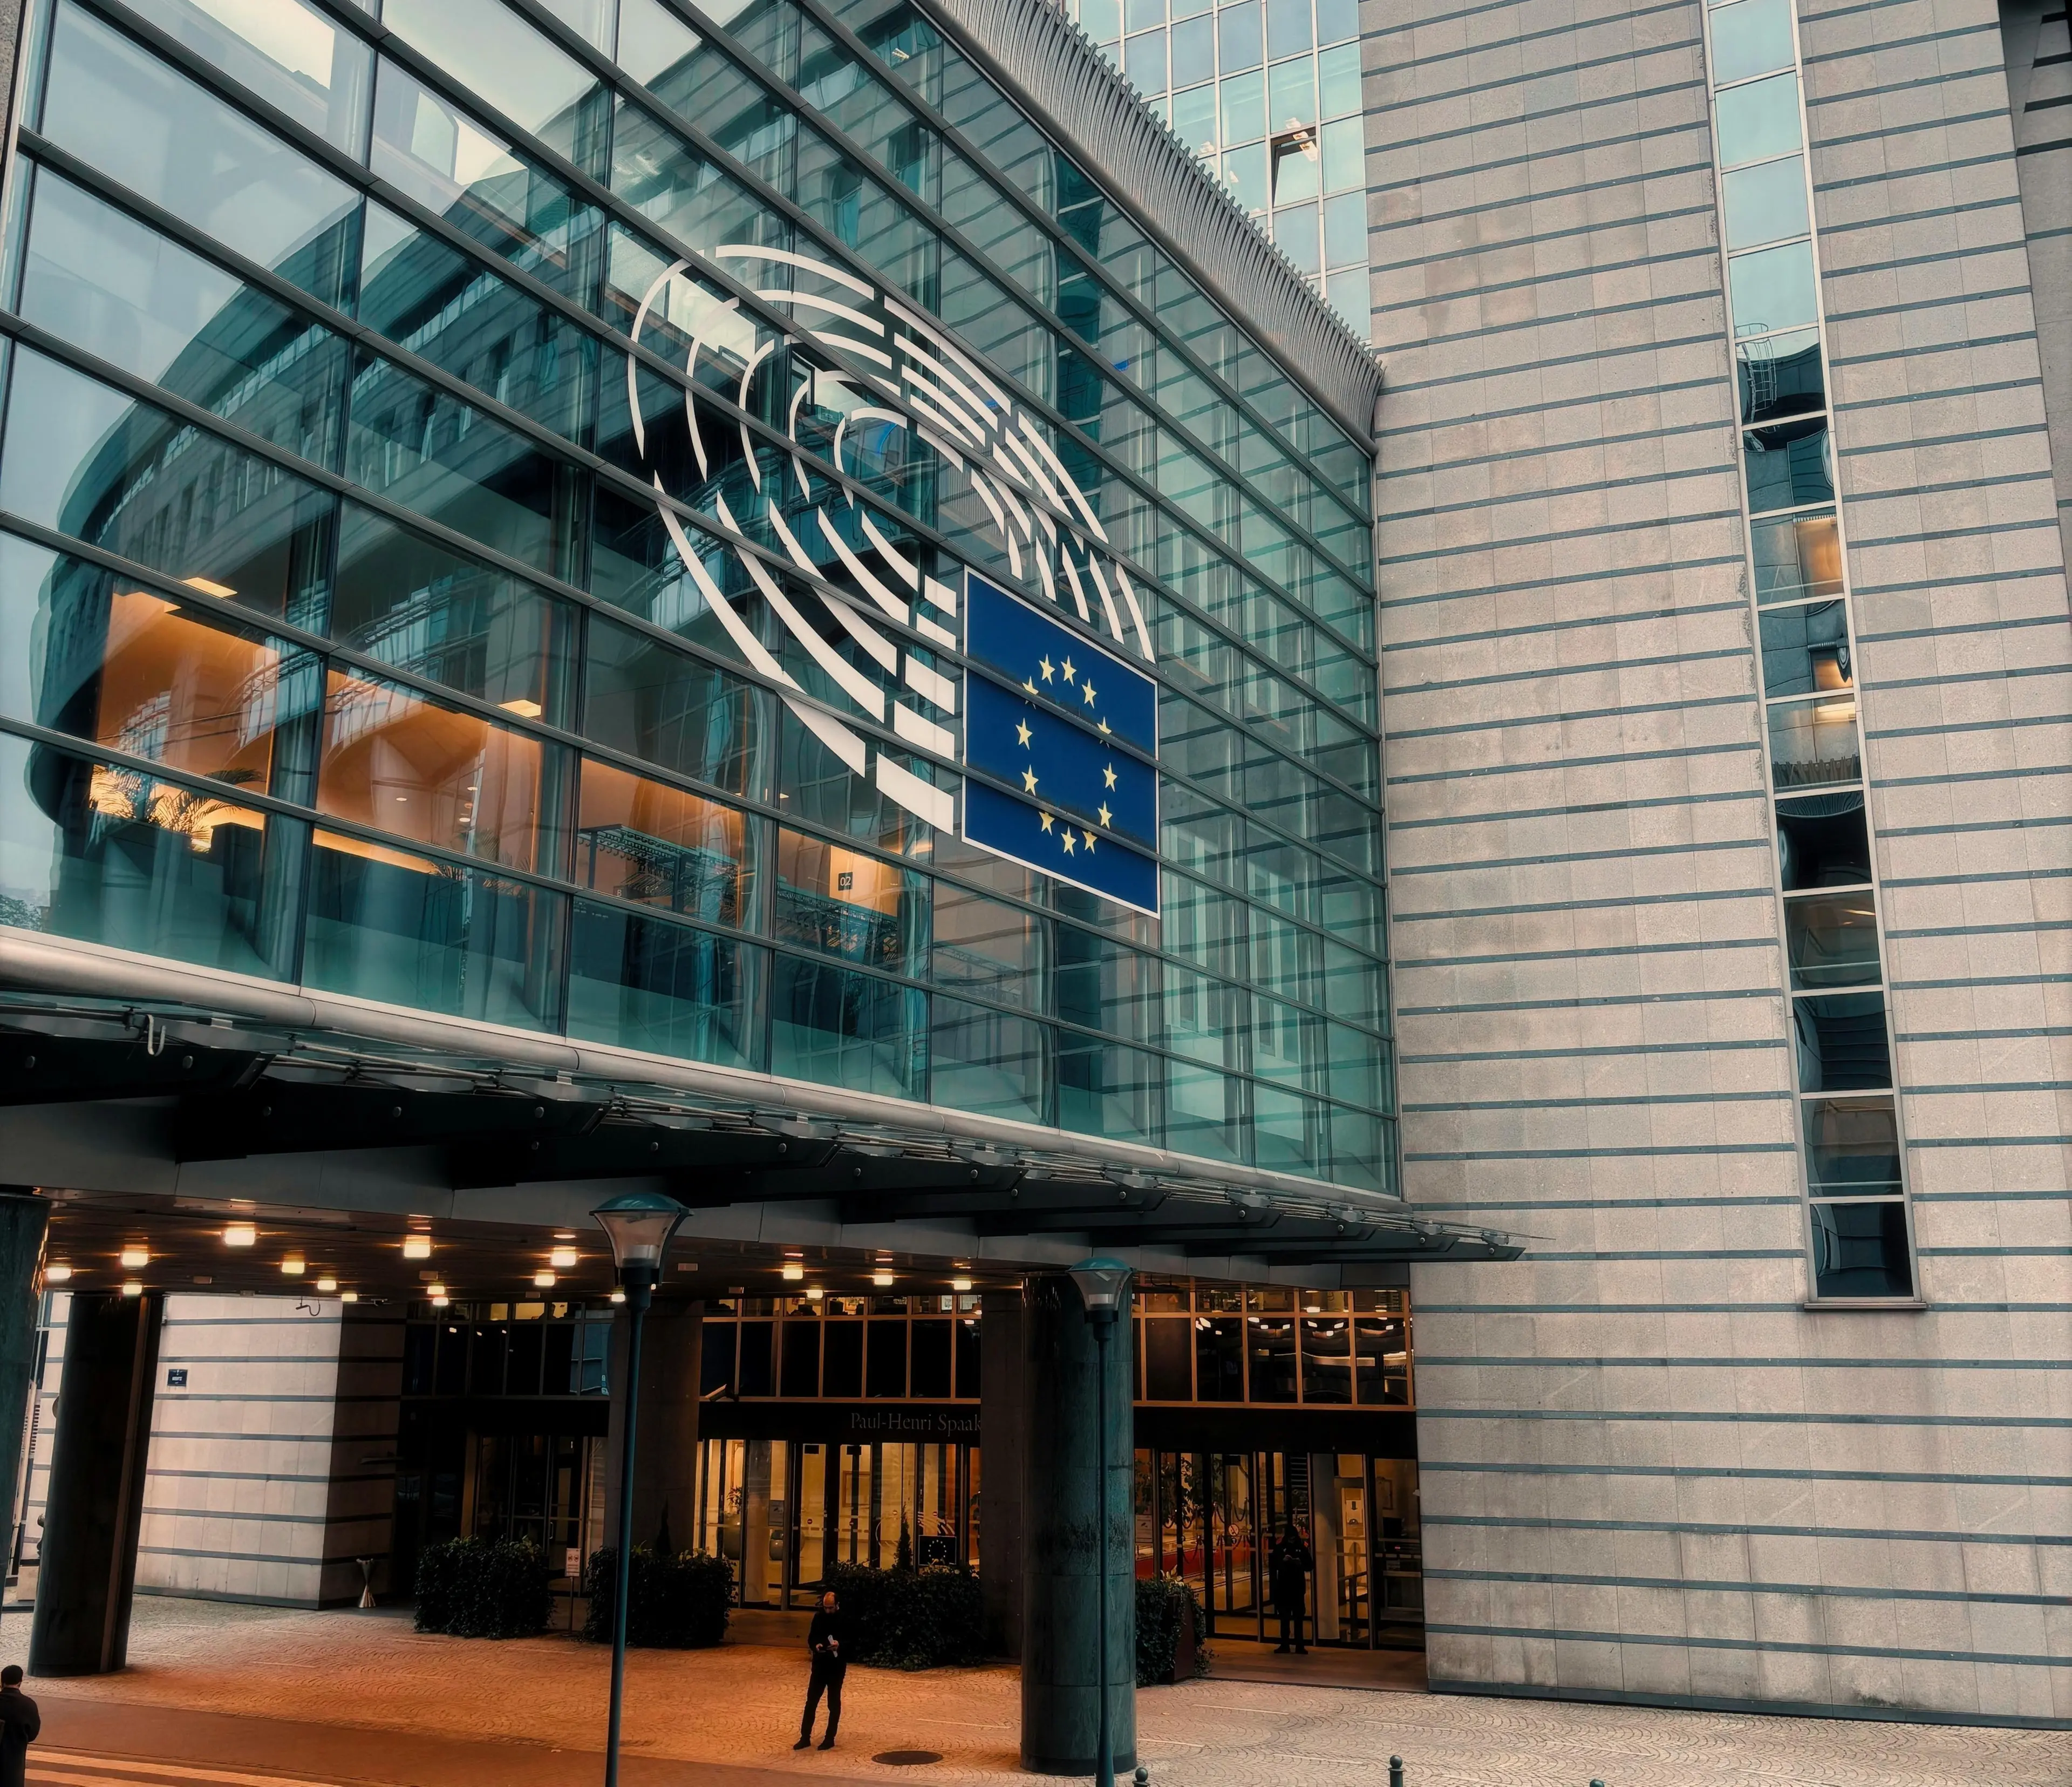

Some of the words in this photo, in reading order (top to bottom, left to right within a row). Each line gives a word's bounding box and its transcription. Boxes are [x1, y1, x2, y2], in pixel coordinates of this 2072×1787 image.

[840, 876, 851, 886] 02
[850, 1412, 931, 1430] Paul-Henri
[938, 1413, 981, 1437] Spaak
